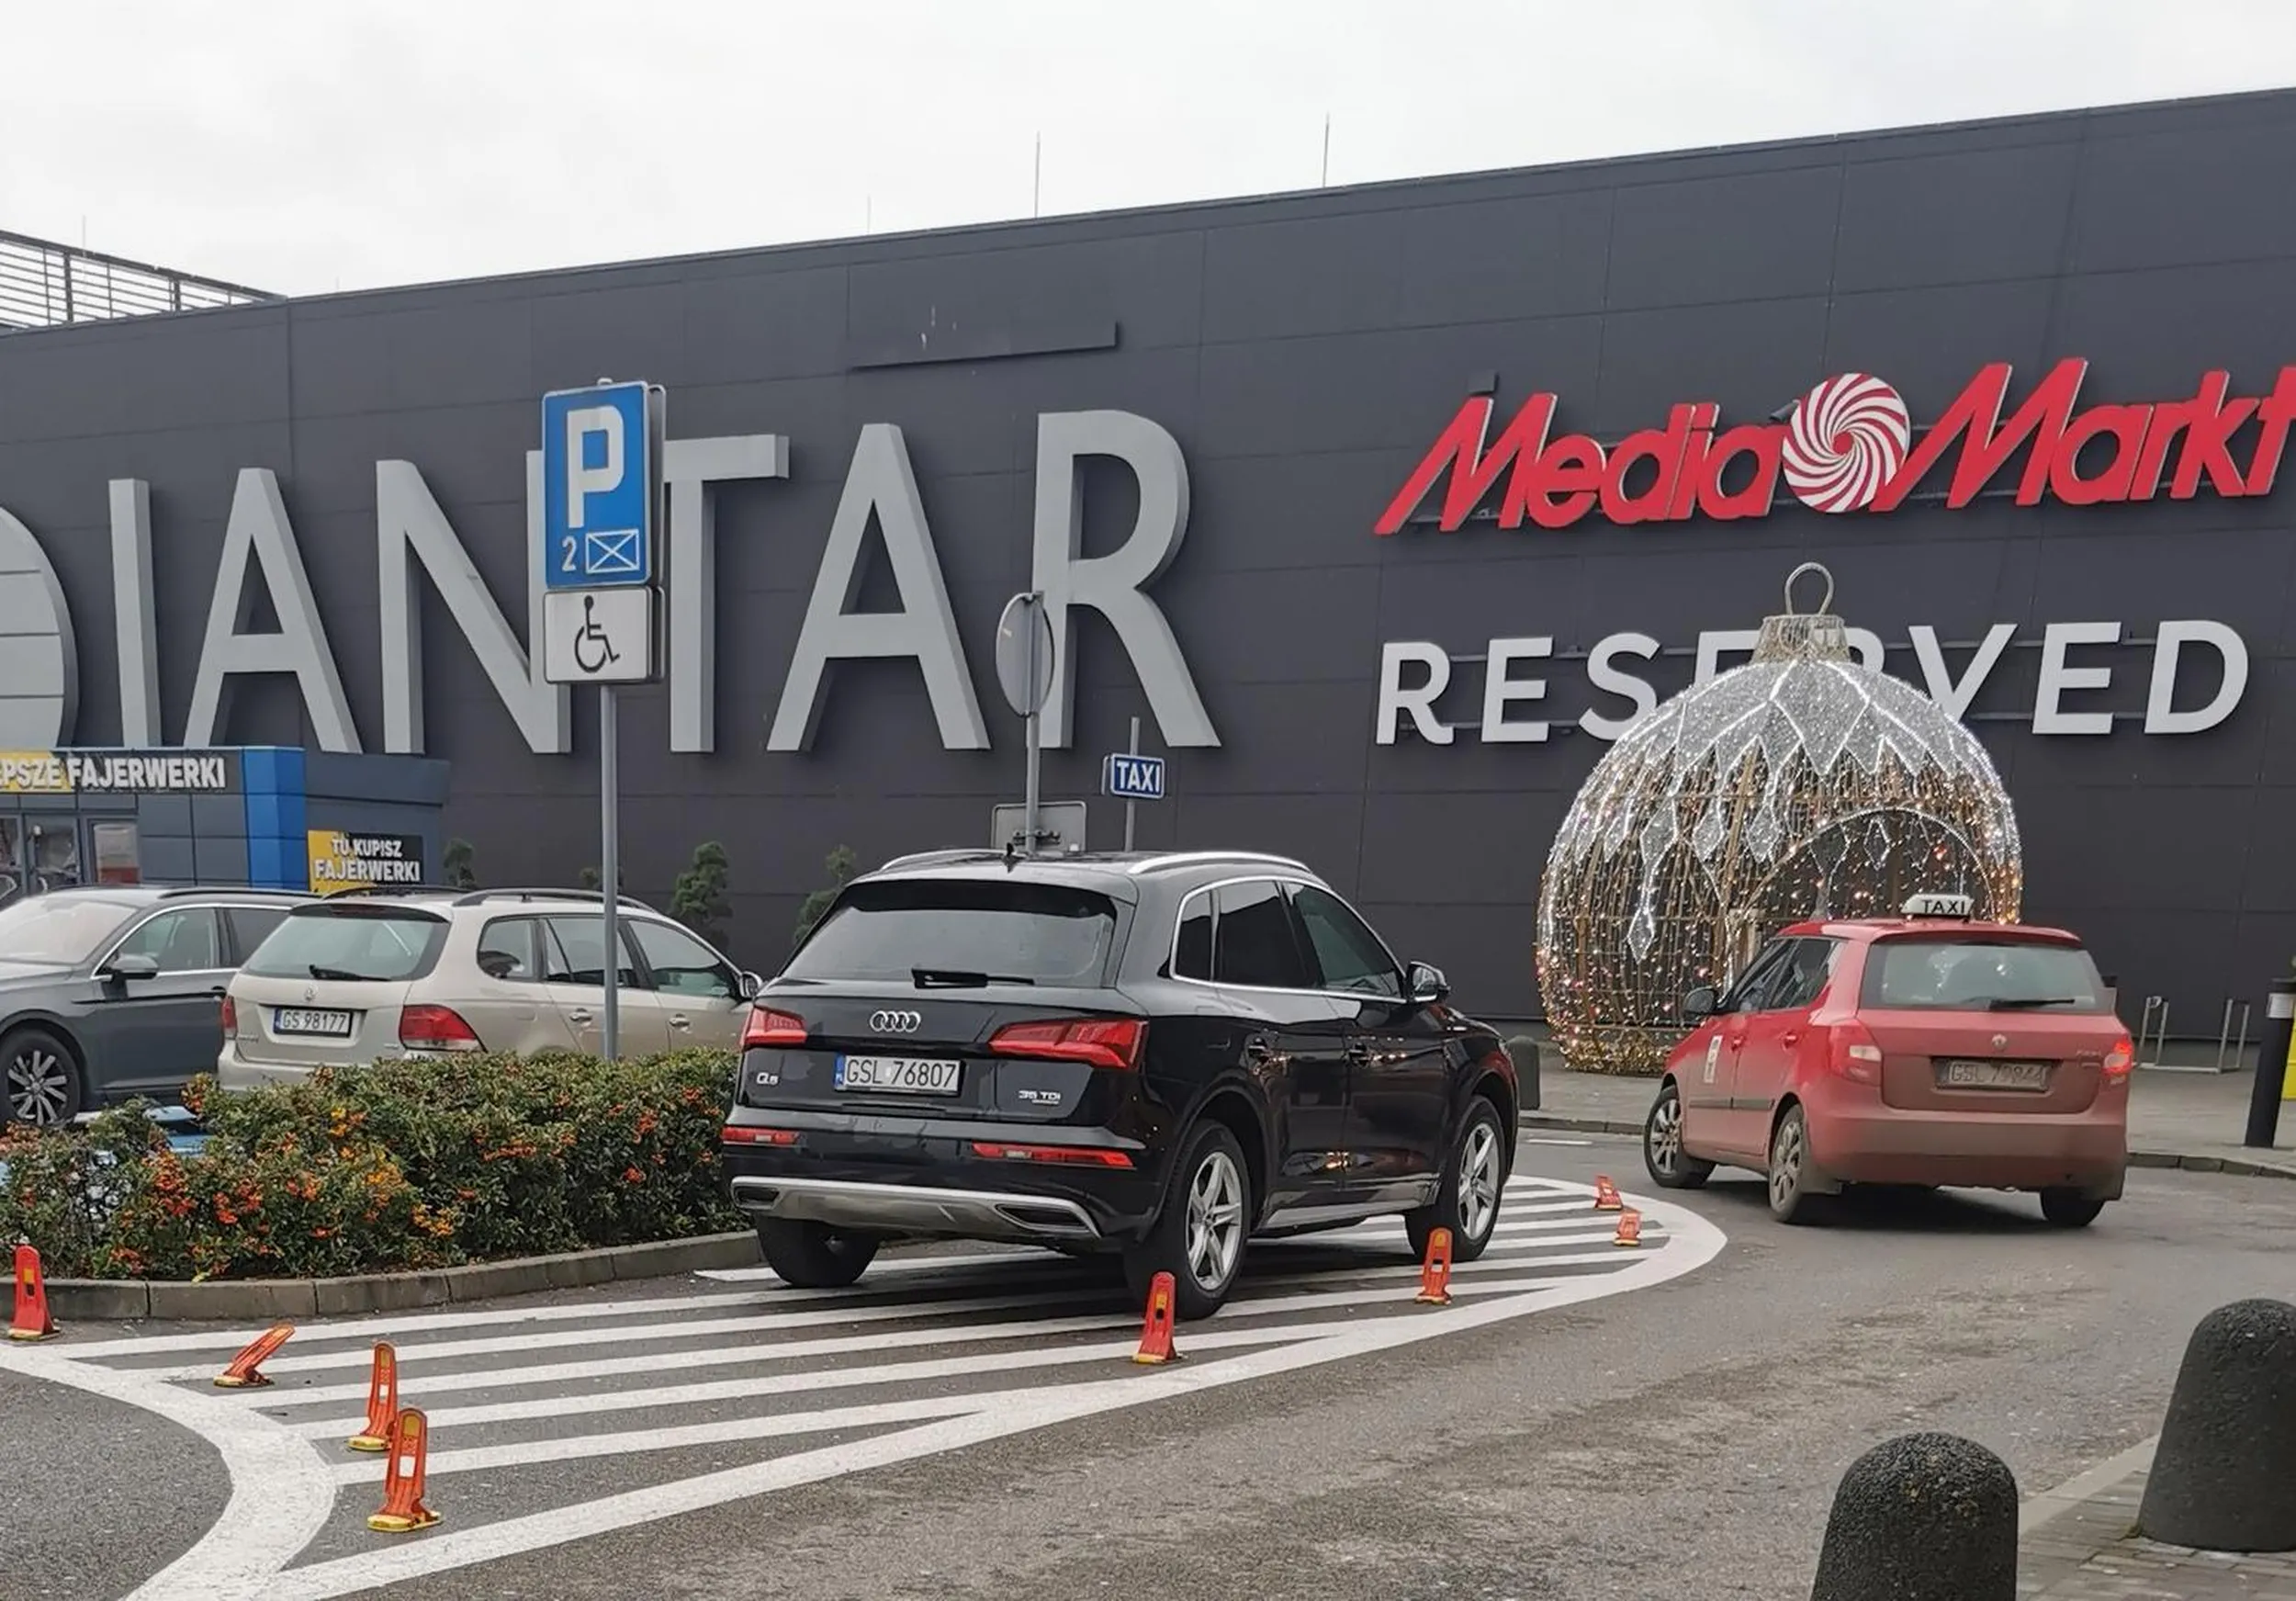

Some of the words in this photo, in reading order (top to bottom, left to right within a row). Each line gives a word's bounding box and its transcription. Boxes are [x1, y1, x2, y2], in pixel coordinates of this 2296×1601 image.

[567, 406, 625, 529] P
[561, 536, 577, 572] 2
[1376, 619, 2249, 746] RESVED
[0, 757, 62, 788] PSZE
[67, 757, 227, 789] FAJERWERKI
[1116, 760, 1161, 793] TAXI
[353, 838, 403, 859] KUPISZ
[314, 858, 422, 882] FAJERWERKI
[1921, 899, 1965, 914] TAXI
[282, 1009, 300, 1030] GS
[303, 1010, 346, 1033] 98177
[846, 1058, 884, 1085] GSL
[891, 1059, 957, 1088] 76807
[1039, 1090, 1062, 1101] TDI
